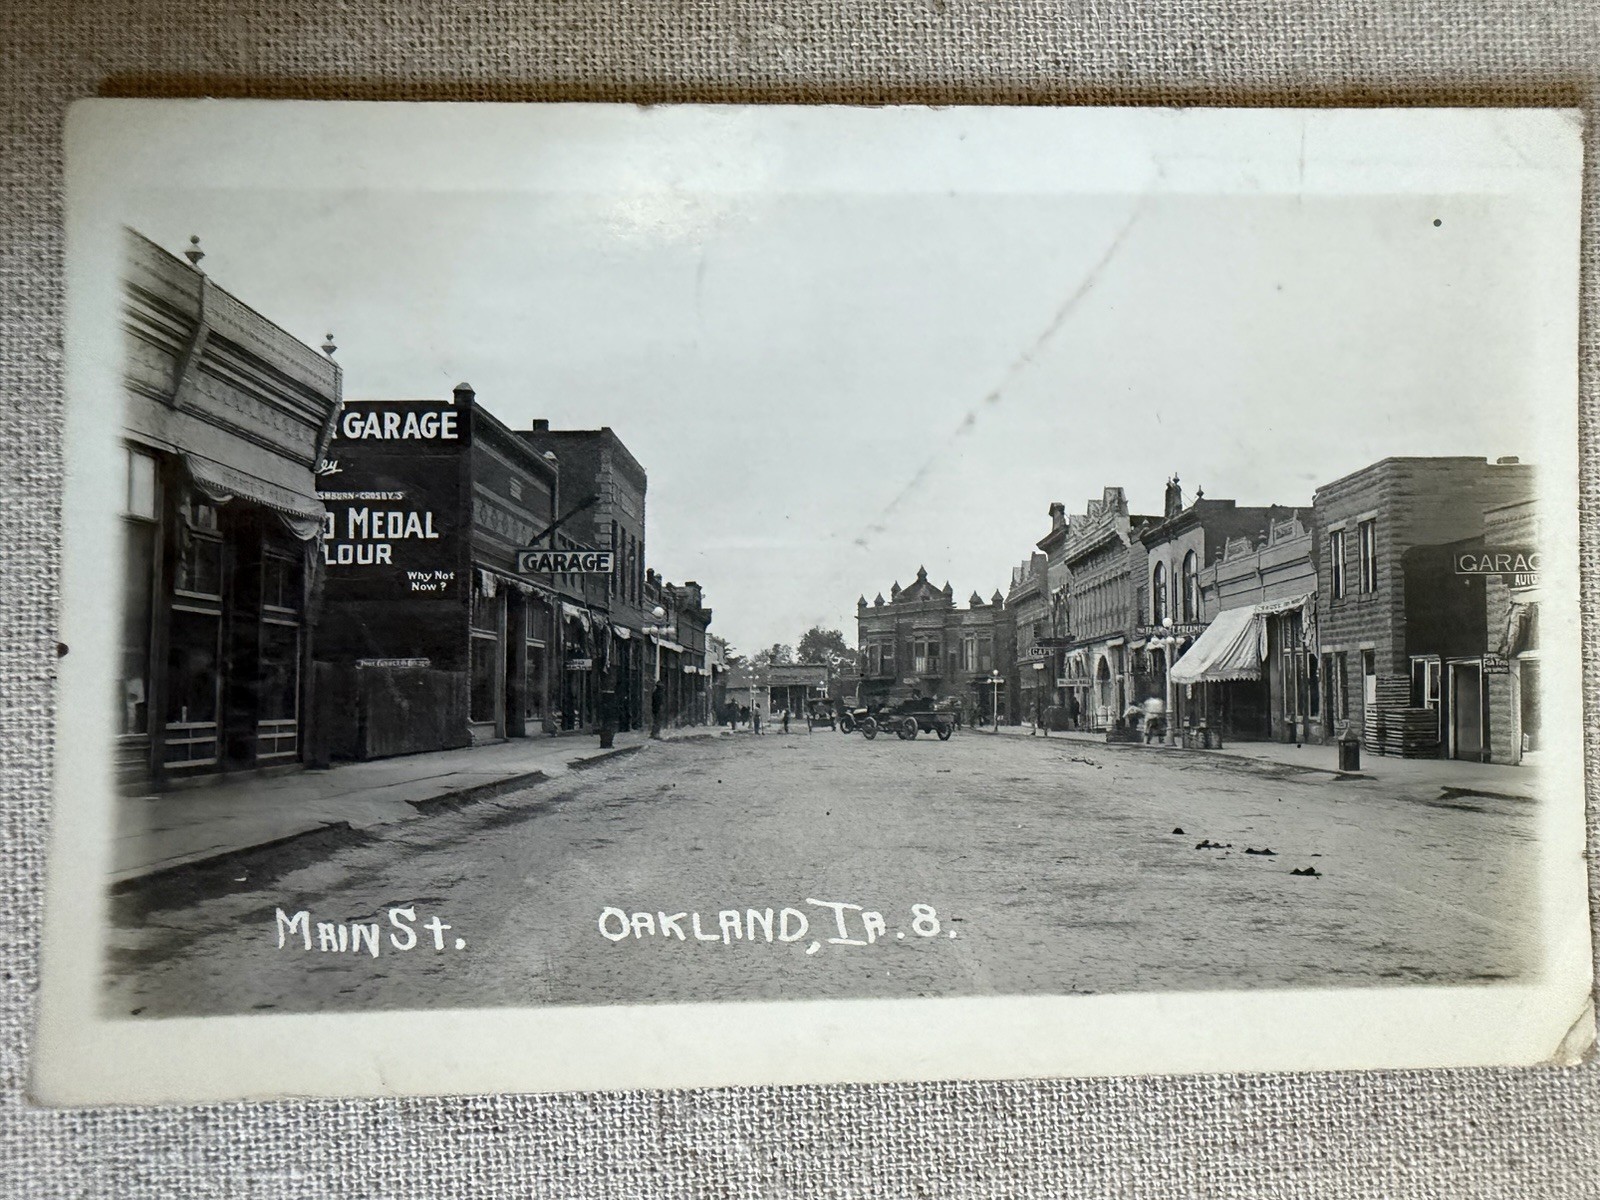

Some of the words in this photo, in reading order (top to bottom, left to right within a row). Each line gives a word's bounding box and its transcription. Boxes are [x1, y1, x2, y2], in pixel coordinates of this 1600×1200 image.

[343, 411, 459, 440] GARAGE
[348, 507, 440, 539] MEDAL
[323, 543, 394, 566] LOUR
[522, 552, 611, 572] GARAGE
[407, 571, 433, 583] Why
[435, 571, 456, 581] Not
[411, 581, 437, 591] Now
[388, 905, 466, 951] St.
